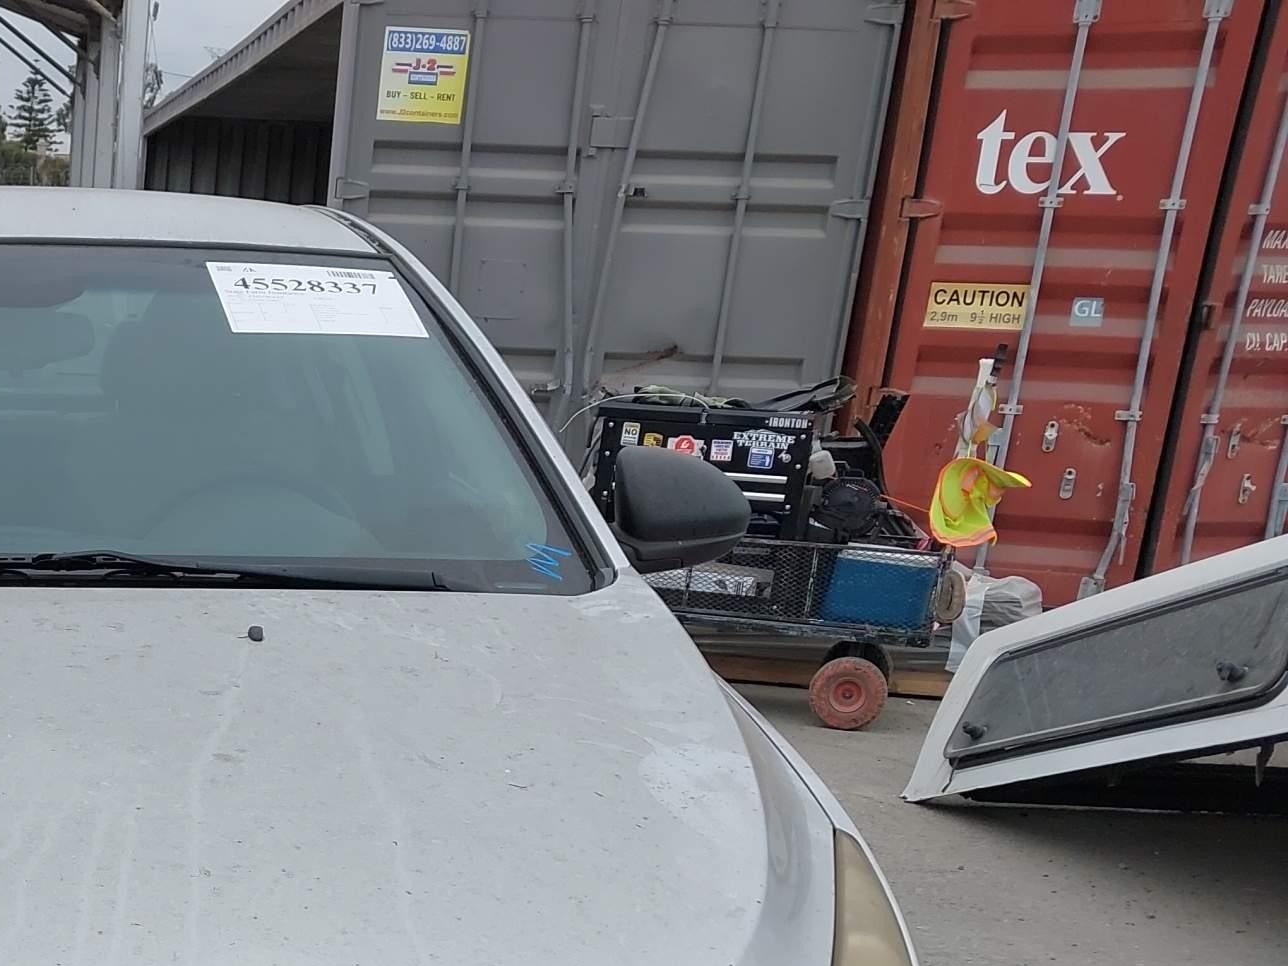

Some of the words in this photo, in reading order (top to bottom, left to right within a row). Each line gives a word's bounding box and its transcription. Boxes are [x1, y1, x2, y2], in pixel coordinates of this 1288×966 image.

[388, 32, 466, 51] (833)269-4887
[386, 90, 401, 98] BUY
[410, 91, 427, 100] SELL
[436, 93, 456, 102] RENT
[976, 109, 1127, 195] tex
[234, 277, 377, 295] 45528337
[933, 288, 1026, 307] CAUTION
[1074, 300, 1101, 317] GL
[989, 313, 1021, 324] HIGH
[624, 427, 638, 436] NO
[733, 431, 796, 444] EXTREME
[736, 439, 789, 450] TERRAIN
